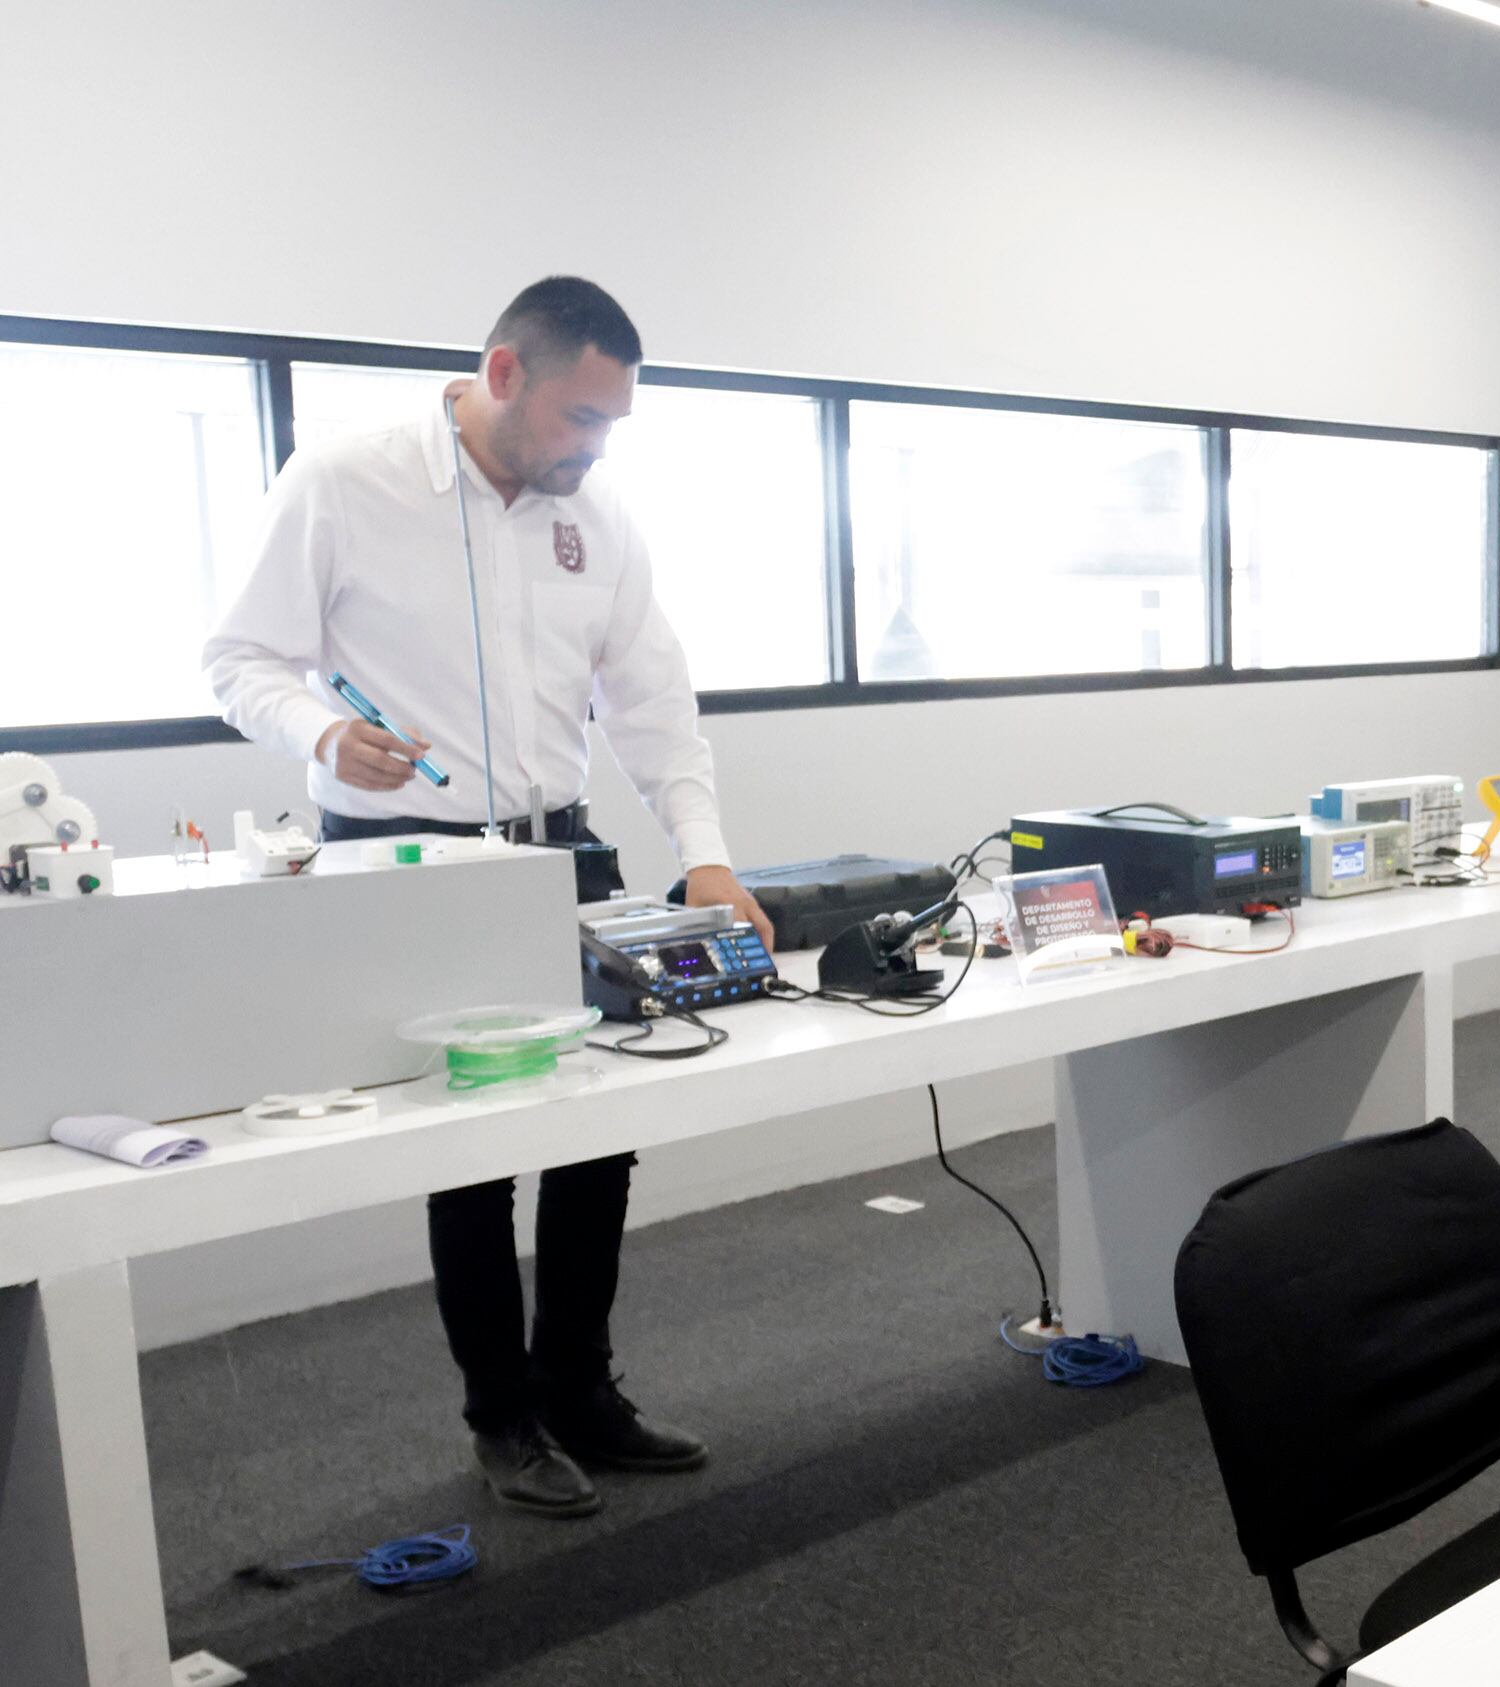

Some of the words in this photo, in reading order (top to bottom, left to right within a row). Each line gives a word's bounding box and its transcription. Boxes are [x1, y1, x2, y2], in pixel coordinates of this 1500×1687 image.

[1021, 899, 1092, 916] DEPARTAMENTO
[1024, 916, 1038, 927] DE
[1038, 909, 1095, 924] DESARROLLO
[1036, 926, 1049, 936] DE
